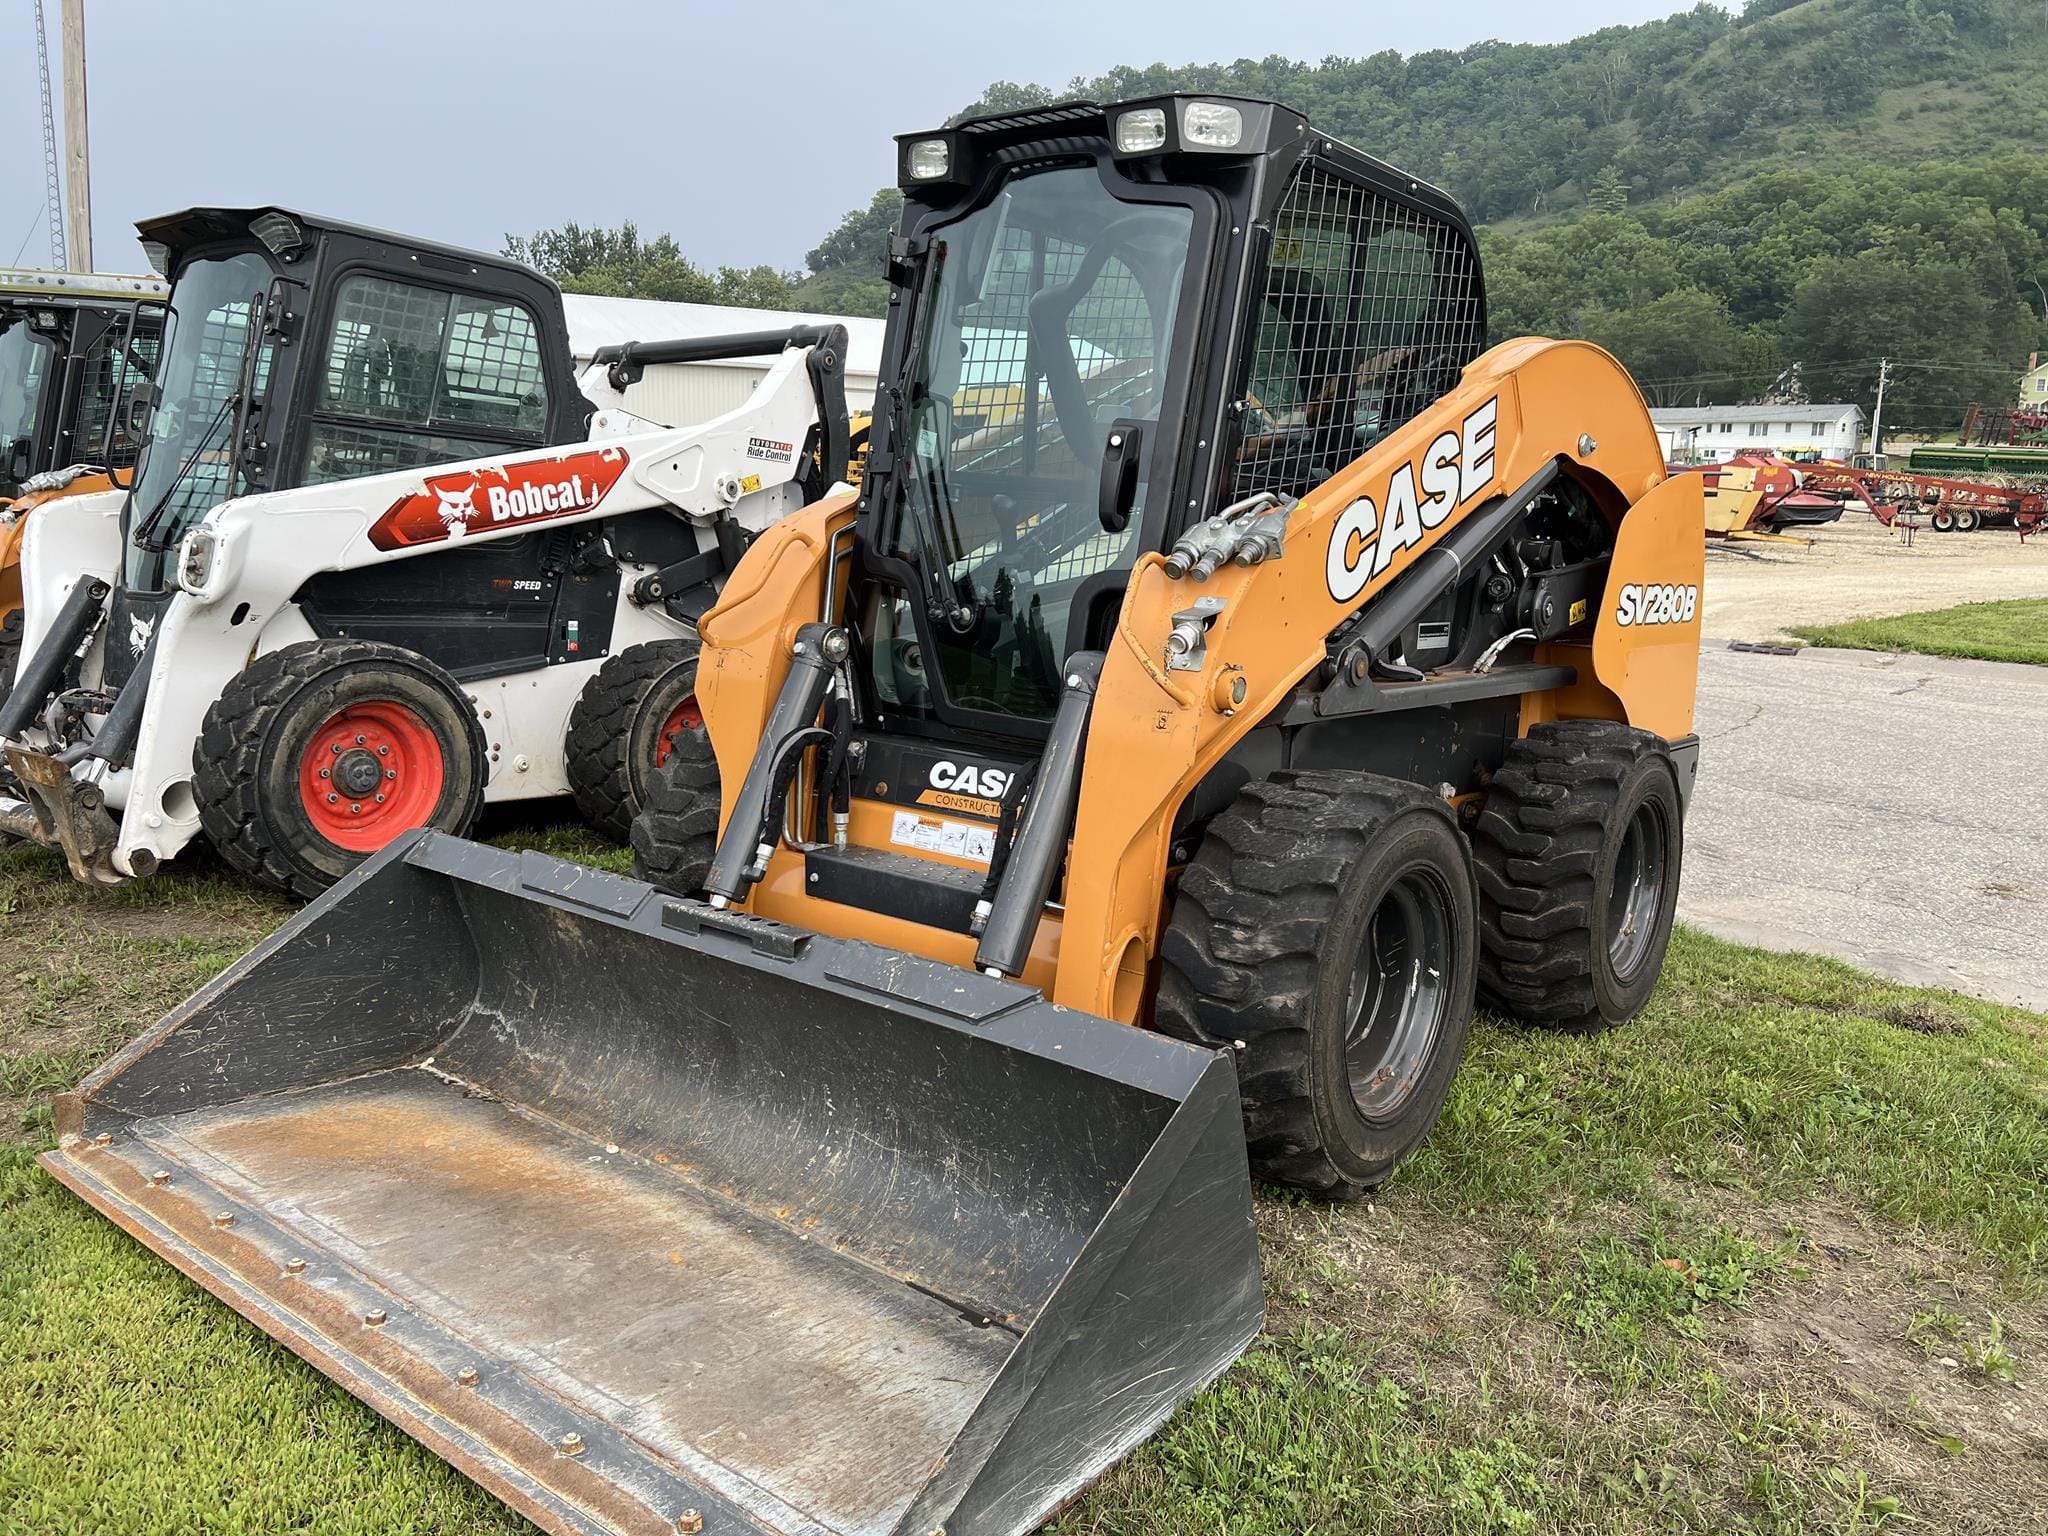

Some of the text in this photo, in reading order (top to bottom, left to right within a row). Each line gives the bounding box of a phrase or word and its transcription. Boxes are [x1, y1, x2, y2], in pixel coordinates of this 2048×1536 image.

[747, 446, 791, 461] Ride Control
[750, 439, 792, 450] AUTOMATIC
[1865, 472, 1881, 480] NEW
[1881, 474, 1914, 482] HOLLAND
[487, 474, 586, 522] Bobcat
[1326, 395, 1498, 604] CASE
[513, 580, 542, 591] SPEED
[1616, 583, 1698, 627] SV280B
[929, 761, 1016, 798] CAS
